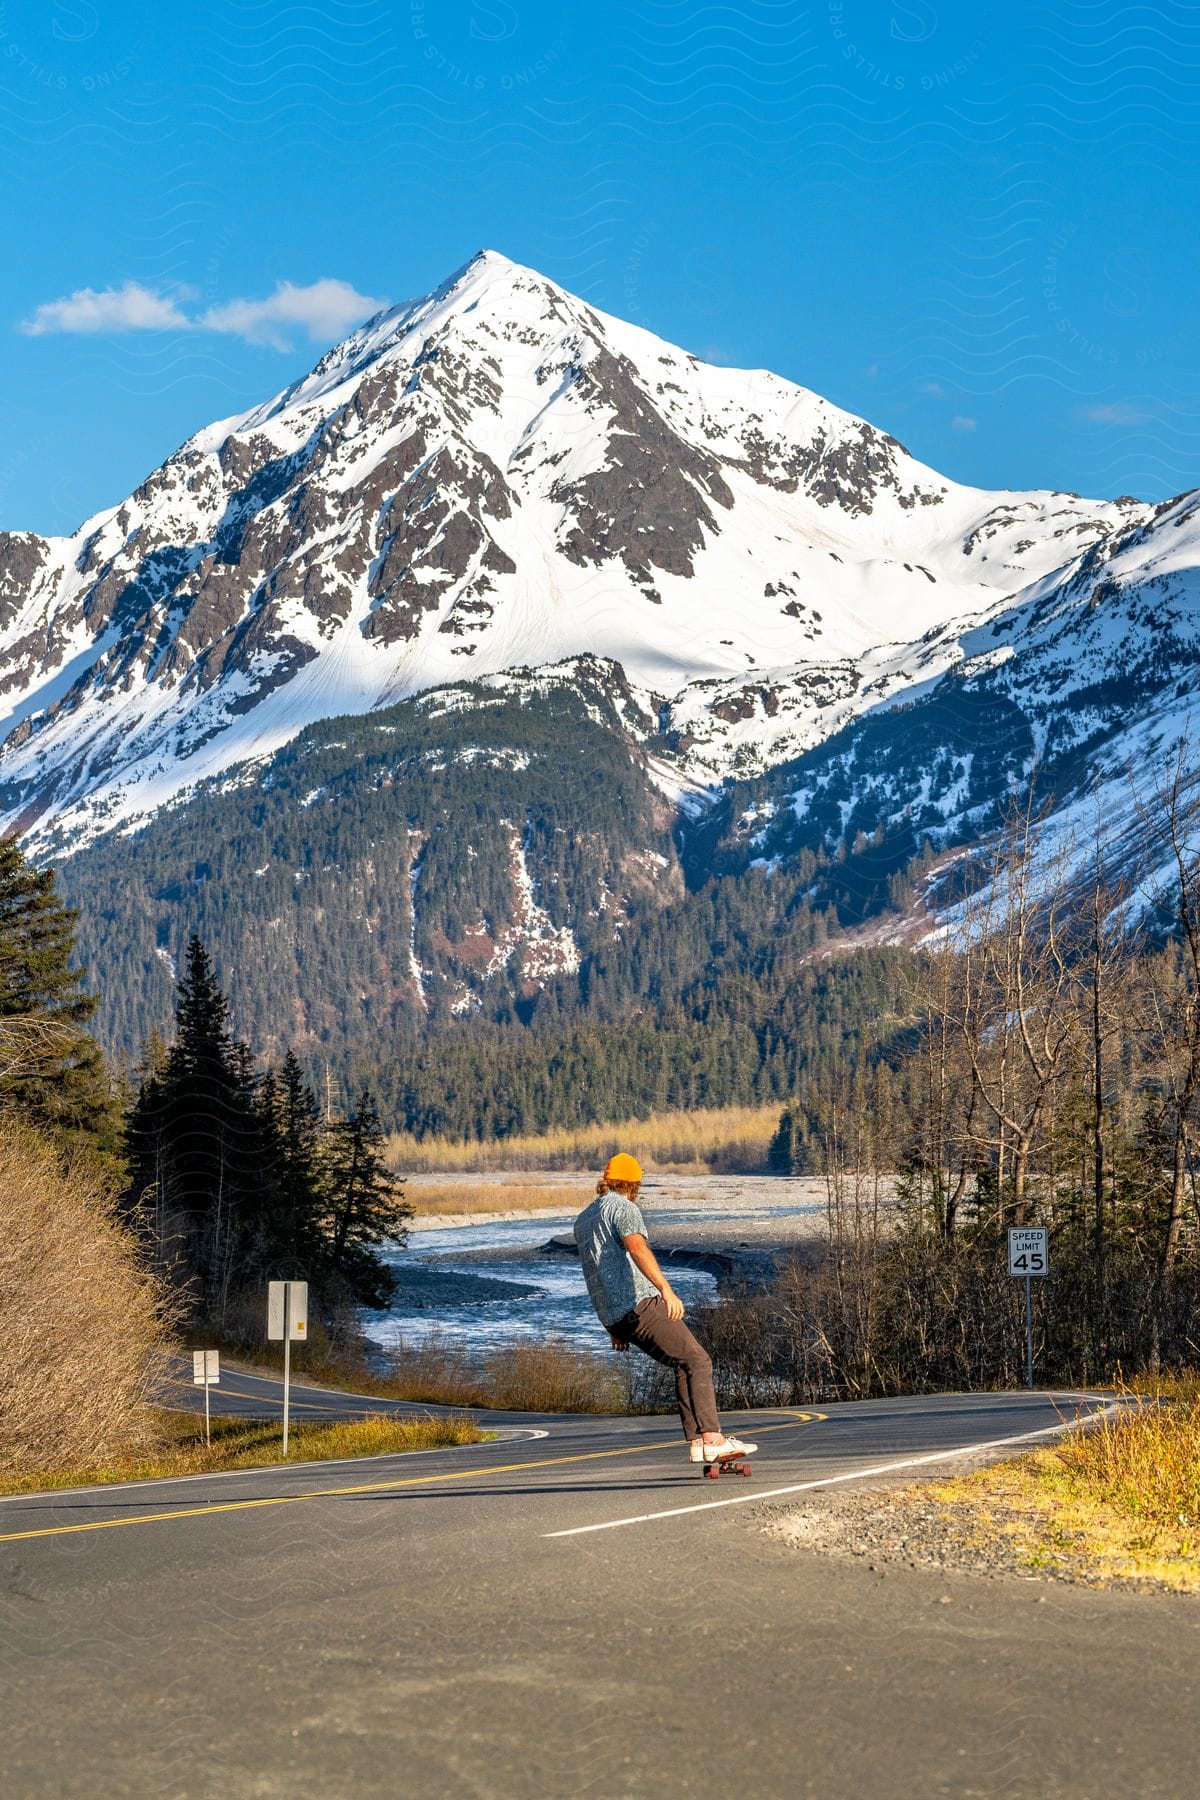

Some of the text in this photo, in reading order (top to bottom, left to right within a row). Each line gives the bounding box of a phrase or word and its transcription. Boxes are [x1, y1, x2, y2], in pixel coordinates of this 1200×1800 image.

[1012, 1232, 1043, 1240] SPEED
[1016, 1242, 1040, 1251] LIMIT
[1013, 1253, 1044, 1270] 45
